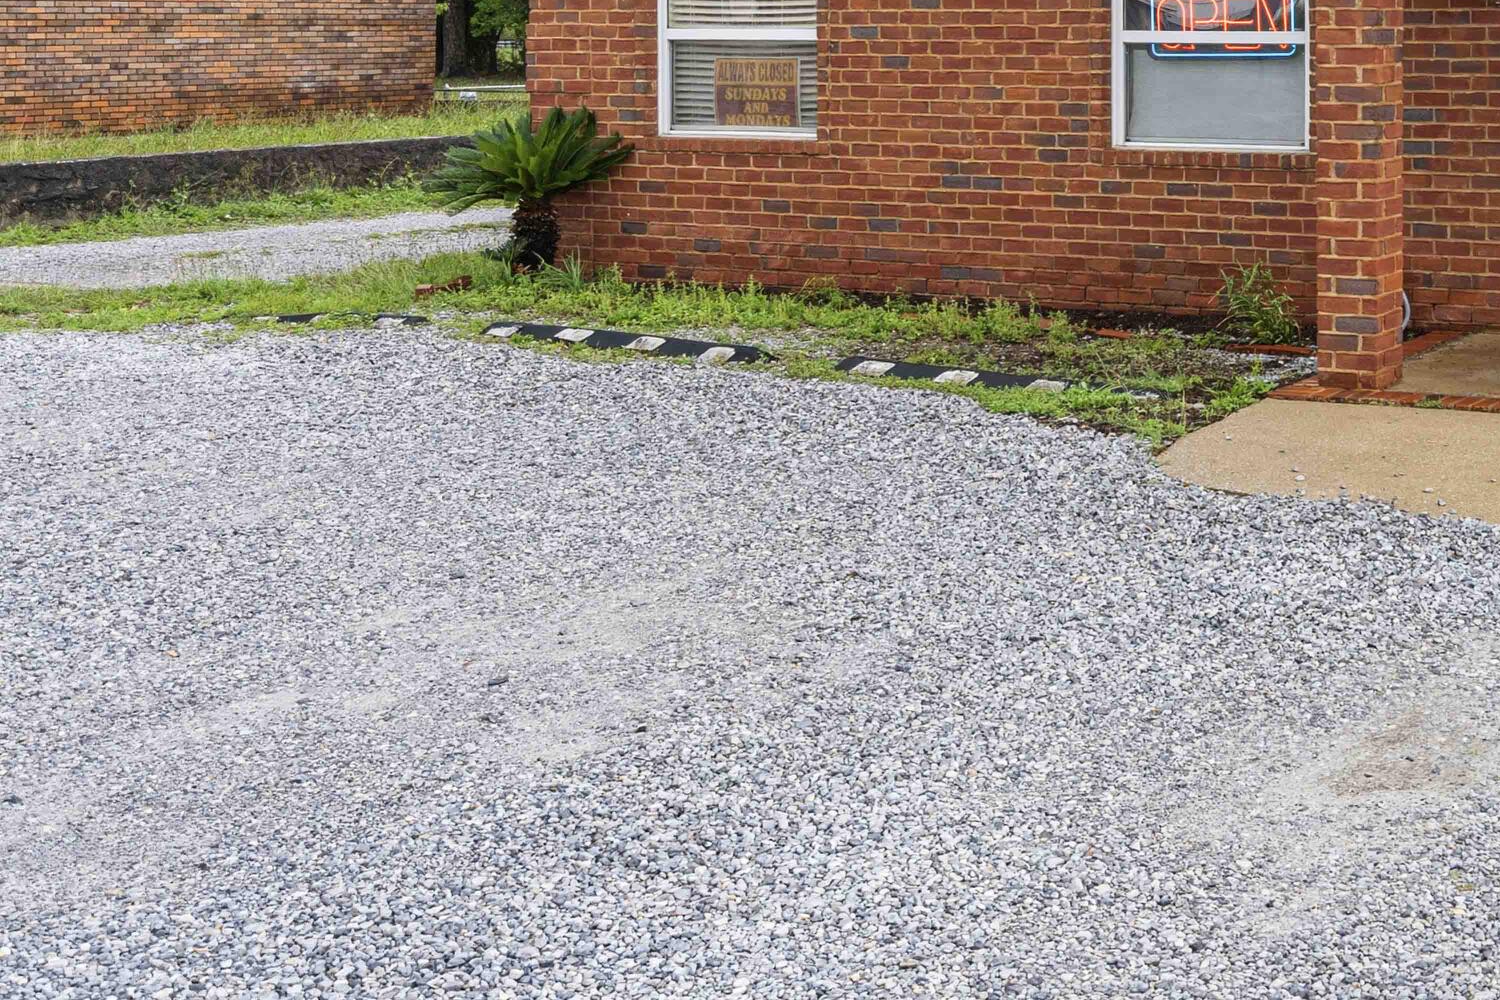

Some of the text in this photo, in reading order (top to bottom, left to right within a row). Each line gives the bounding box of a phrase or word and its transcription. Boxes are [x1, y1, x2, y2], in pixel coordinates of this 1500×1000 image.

[719, 61, 793, 82] ALWAYS CLOSED
[725, 87, 787, 101] SUNDAYS
[744, 102, 769, 113] AND
[725, 113, 791, 126] MONDAYS
